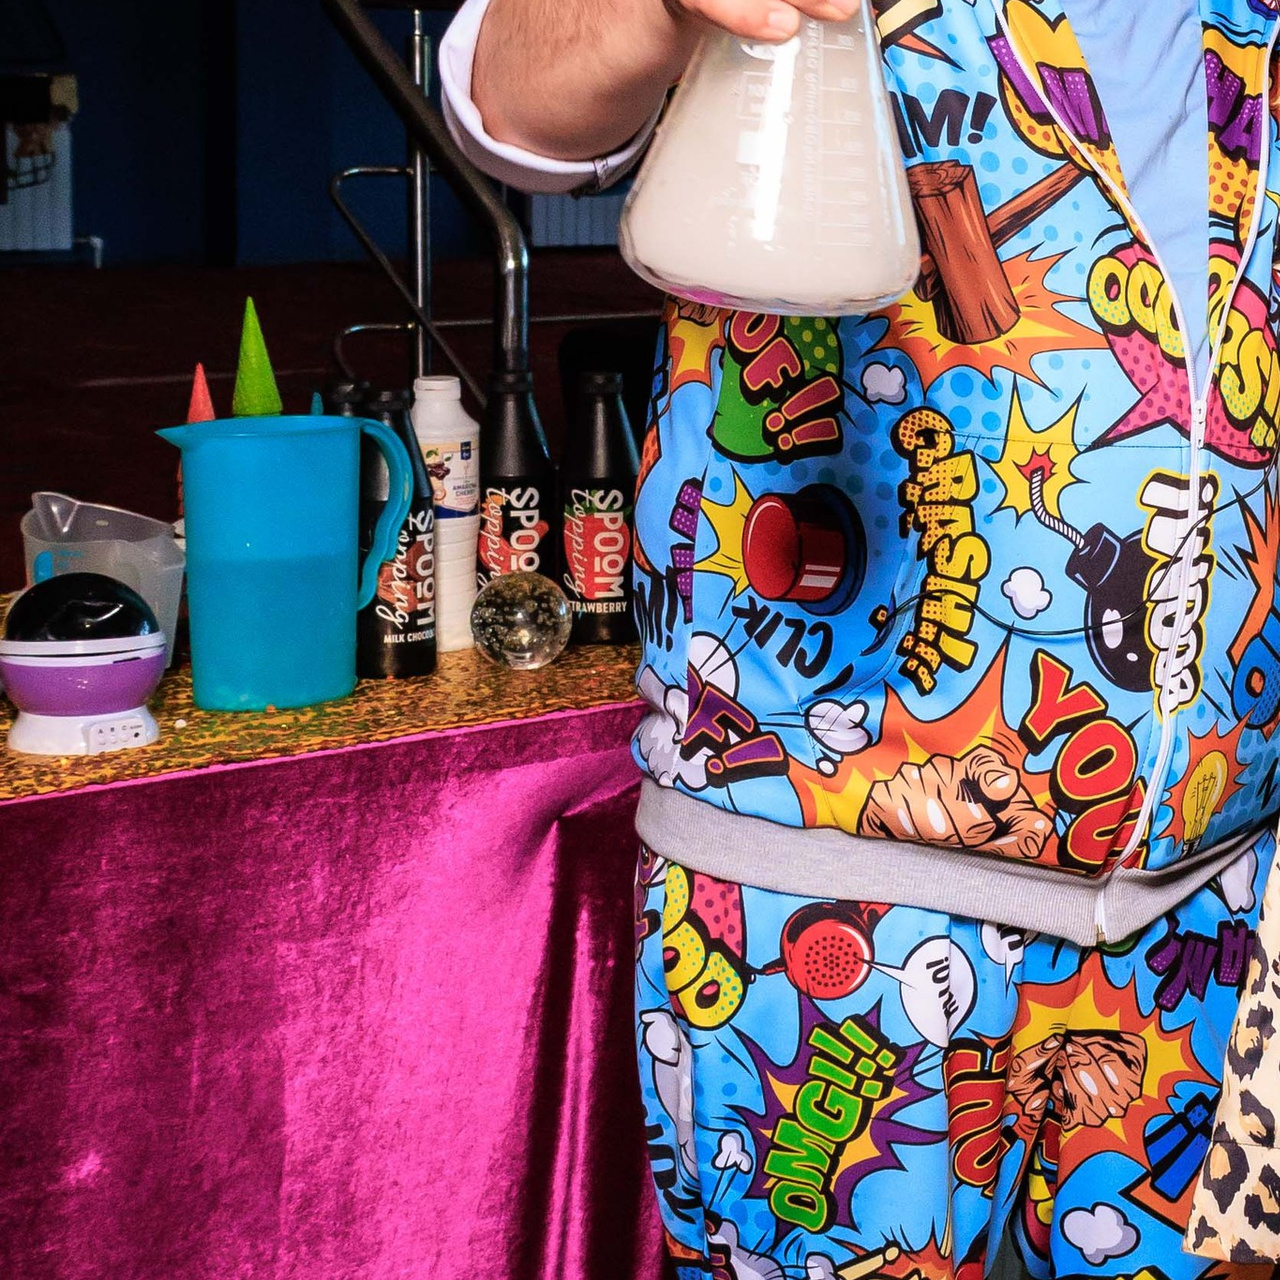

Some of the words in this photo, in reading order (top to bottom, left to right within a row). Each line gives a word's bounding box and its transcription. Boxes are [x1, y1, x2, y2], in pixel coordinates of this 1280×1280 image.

[509, 486, 540, 572] SPOO
[563, 488, 597, 599] topping
[593, 489, 625, 598] SPOOM
[384, 634, 405, 644] MILK
[569, 600, 628, 614] TRAWBERRY
